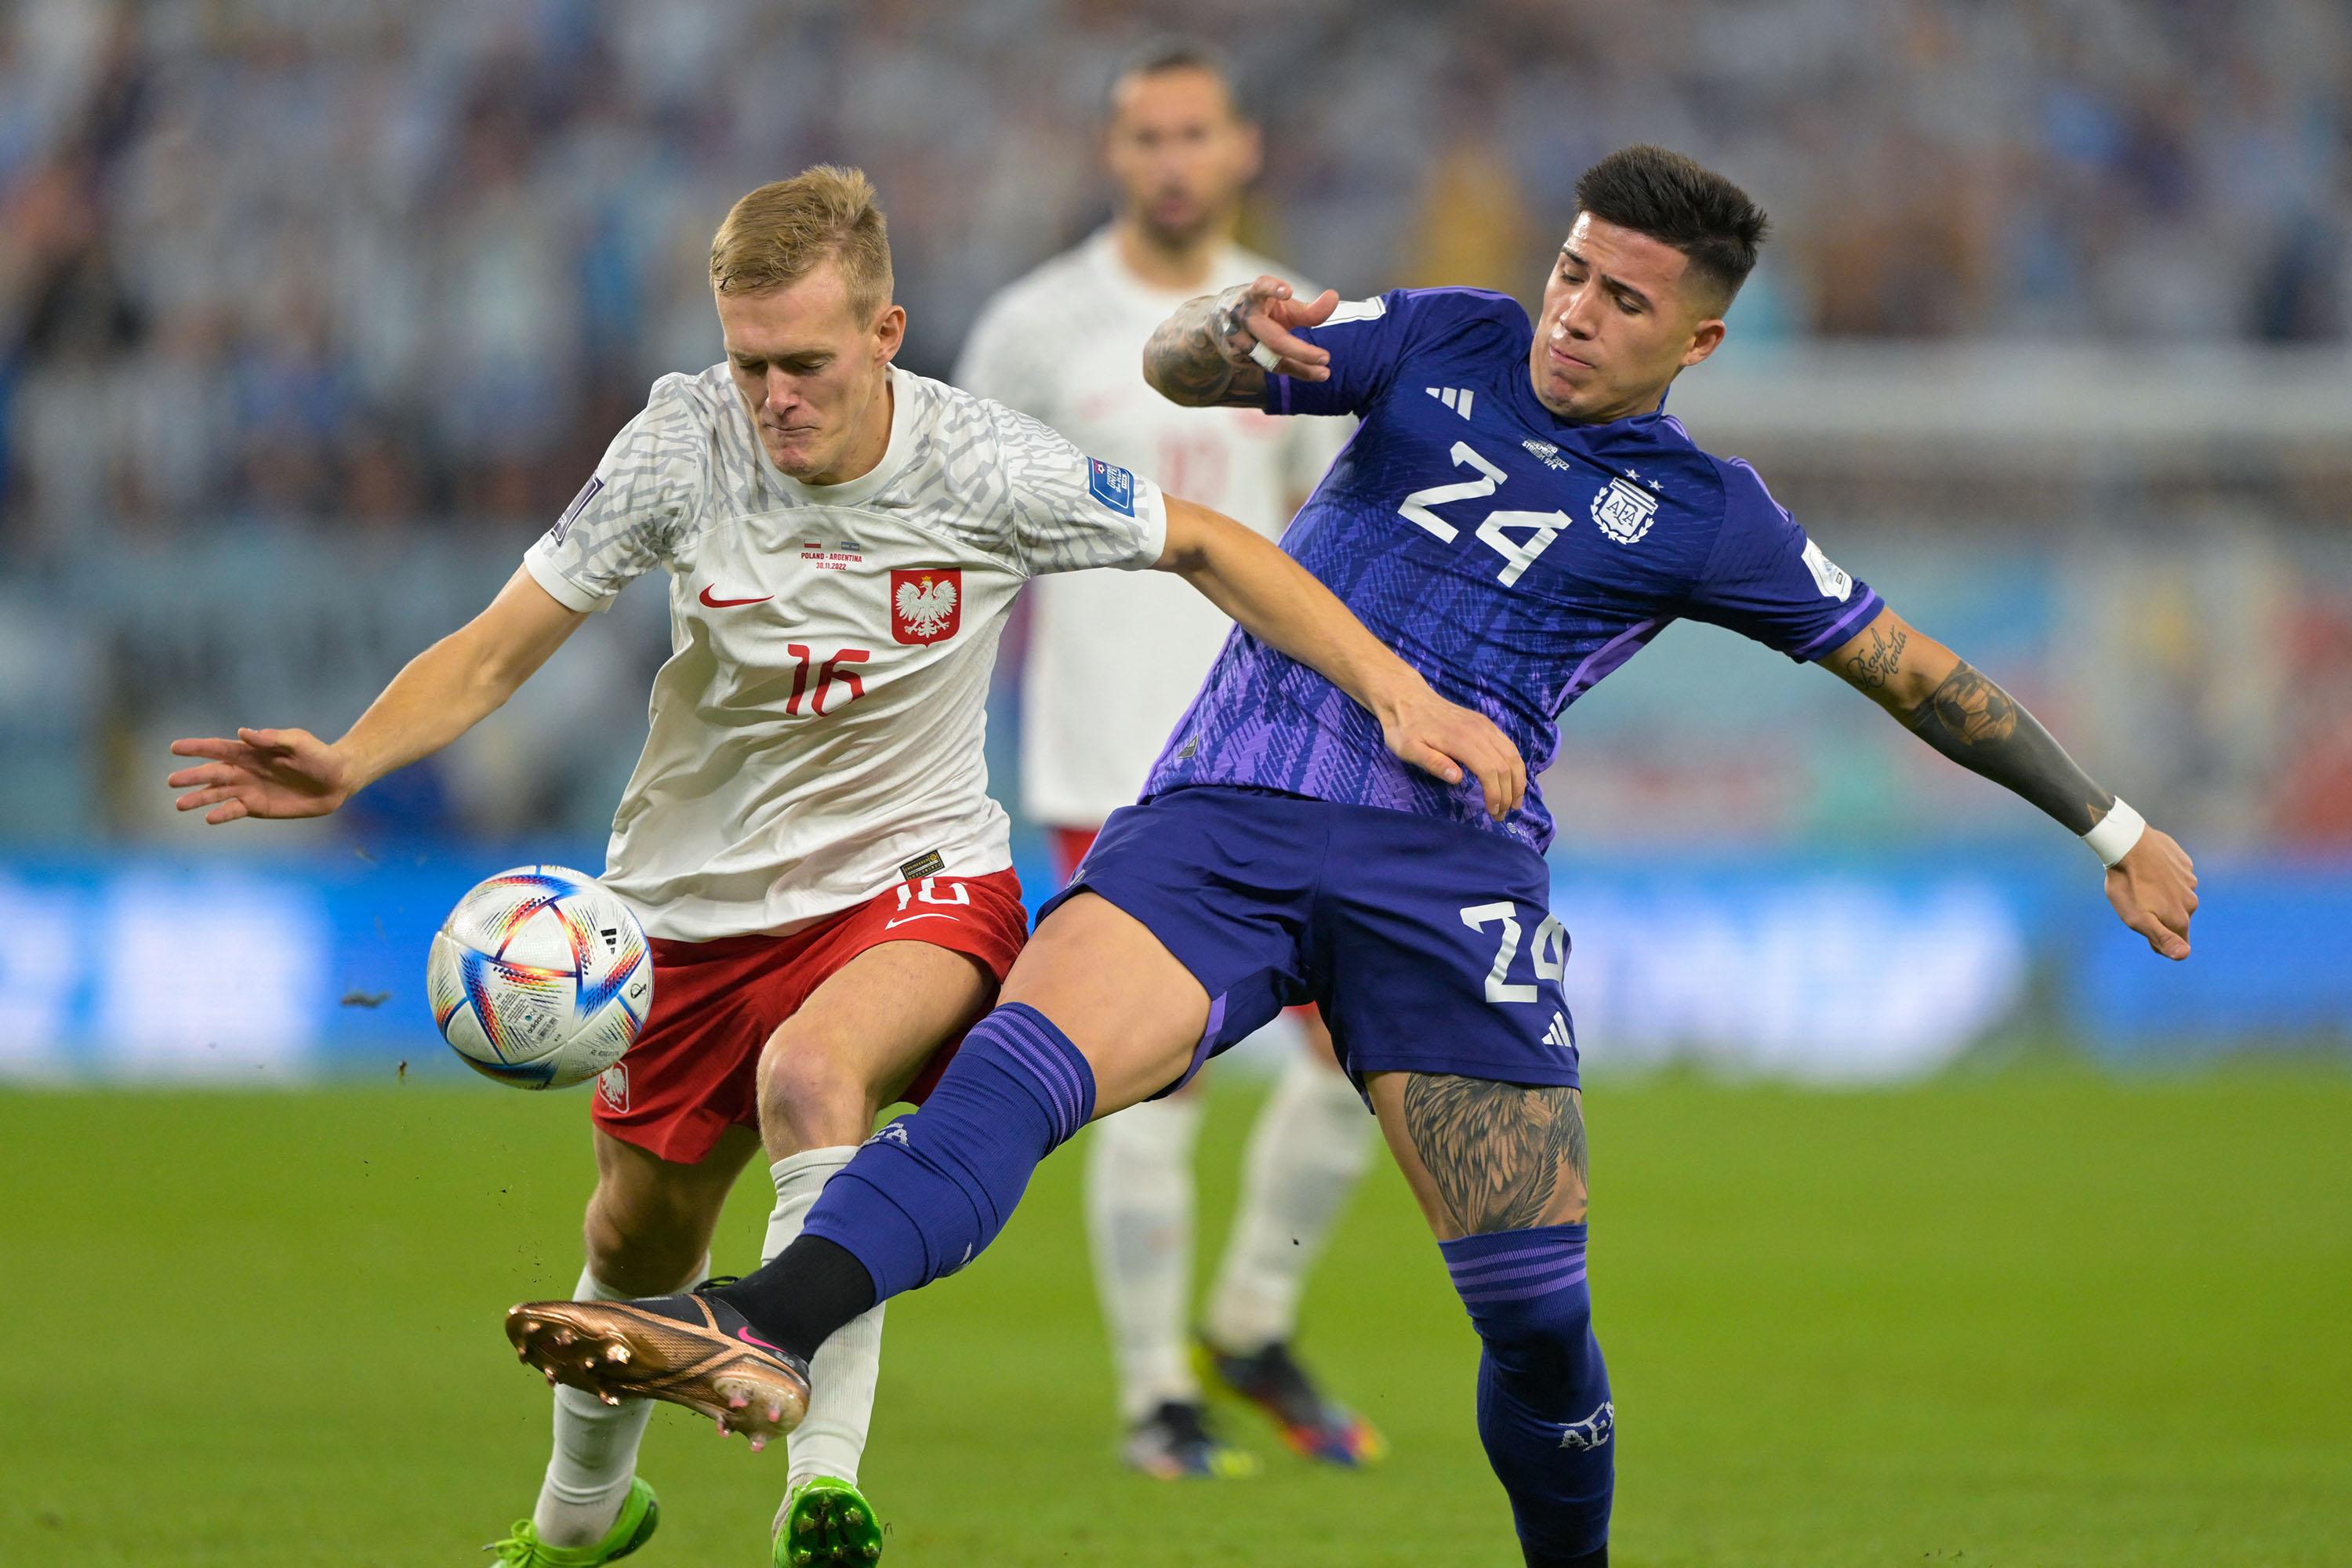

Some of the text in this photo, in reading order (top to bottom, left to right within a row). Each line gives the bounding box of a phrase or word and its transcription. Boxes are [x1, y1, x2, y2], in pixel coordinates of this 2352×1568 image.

[1544, 458, 1557, 470] 974
[1397, 441, 1573, 588] 24
[1606, 495, 1639, 527] AFA
[815, 561, 847, 571] 30.11.2022
[829, 553, 862, 563] ARGENTINA
[786, 644, 870, 717] 16
[1460, 901, 1566, 1004] 24
[527, 1014, 545, 1034] adidas
